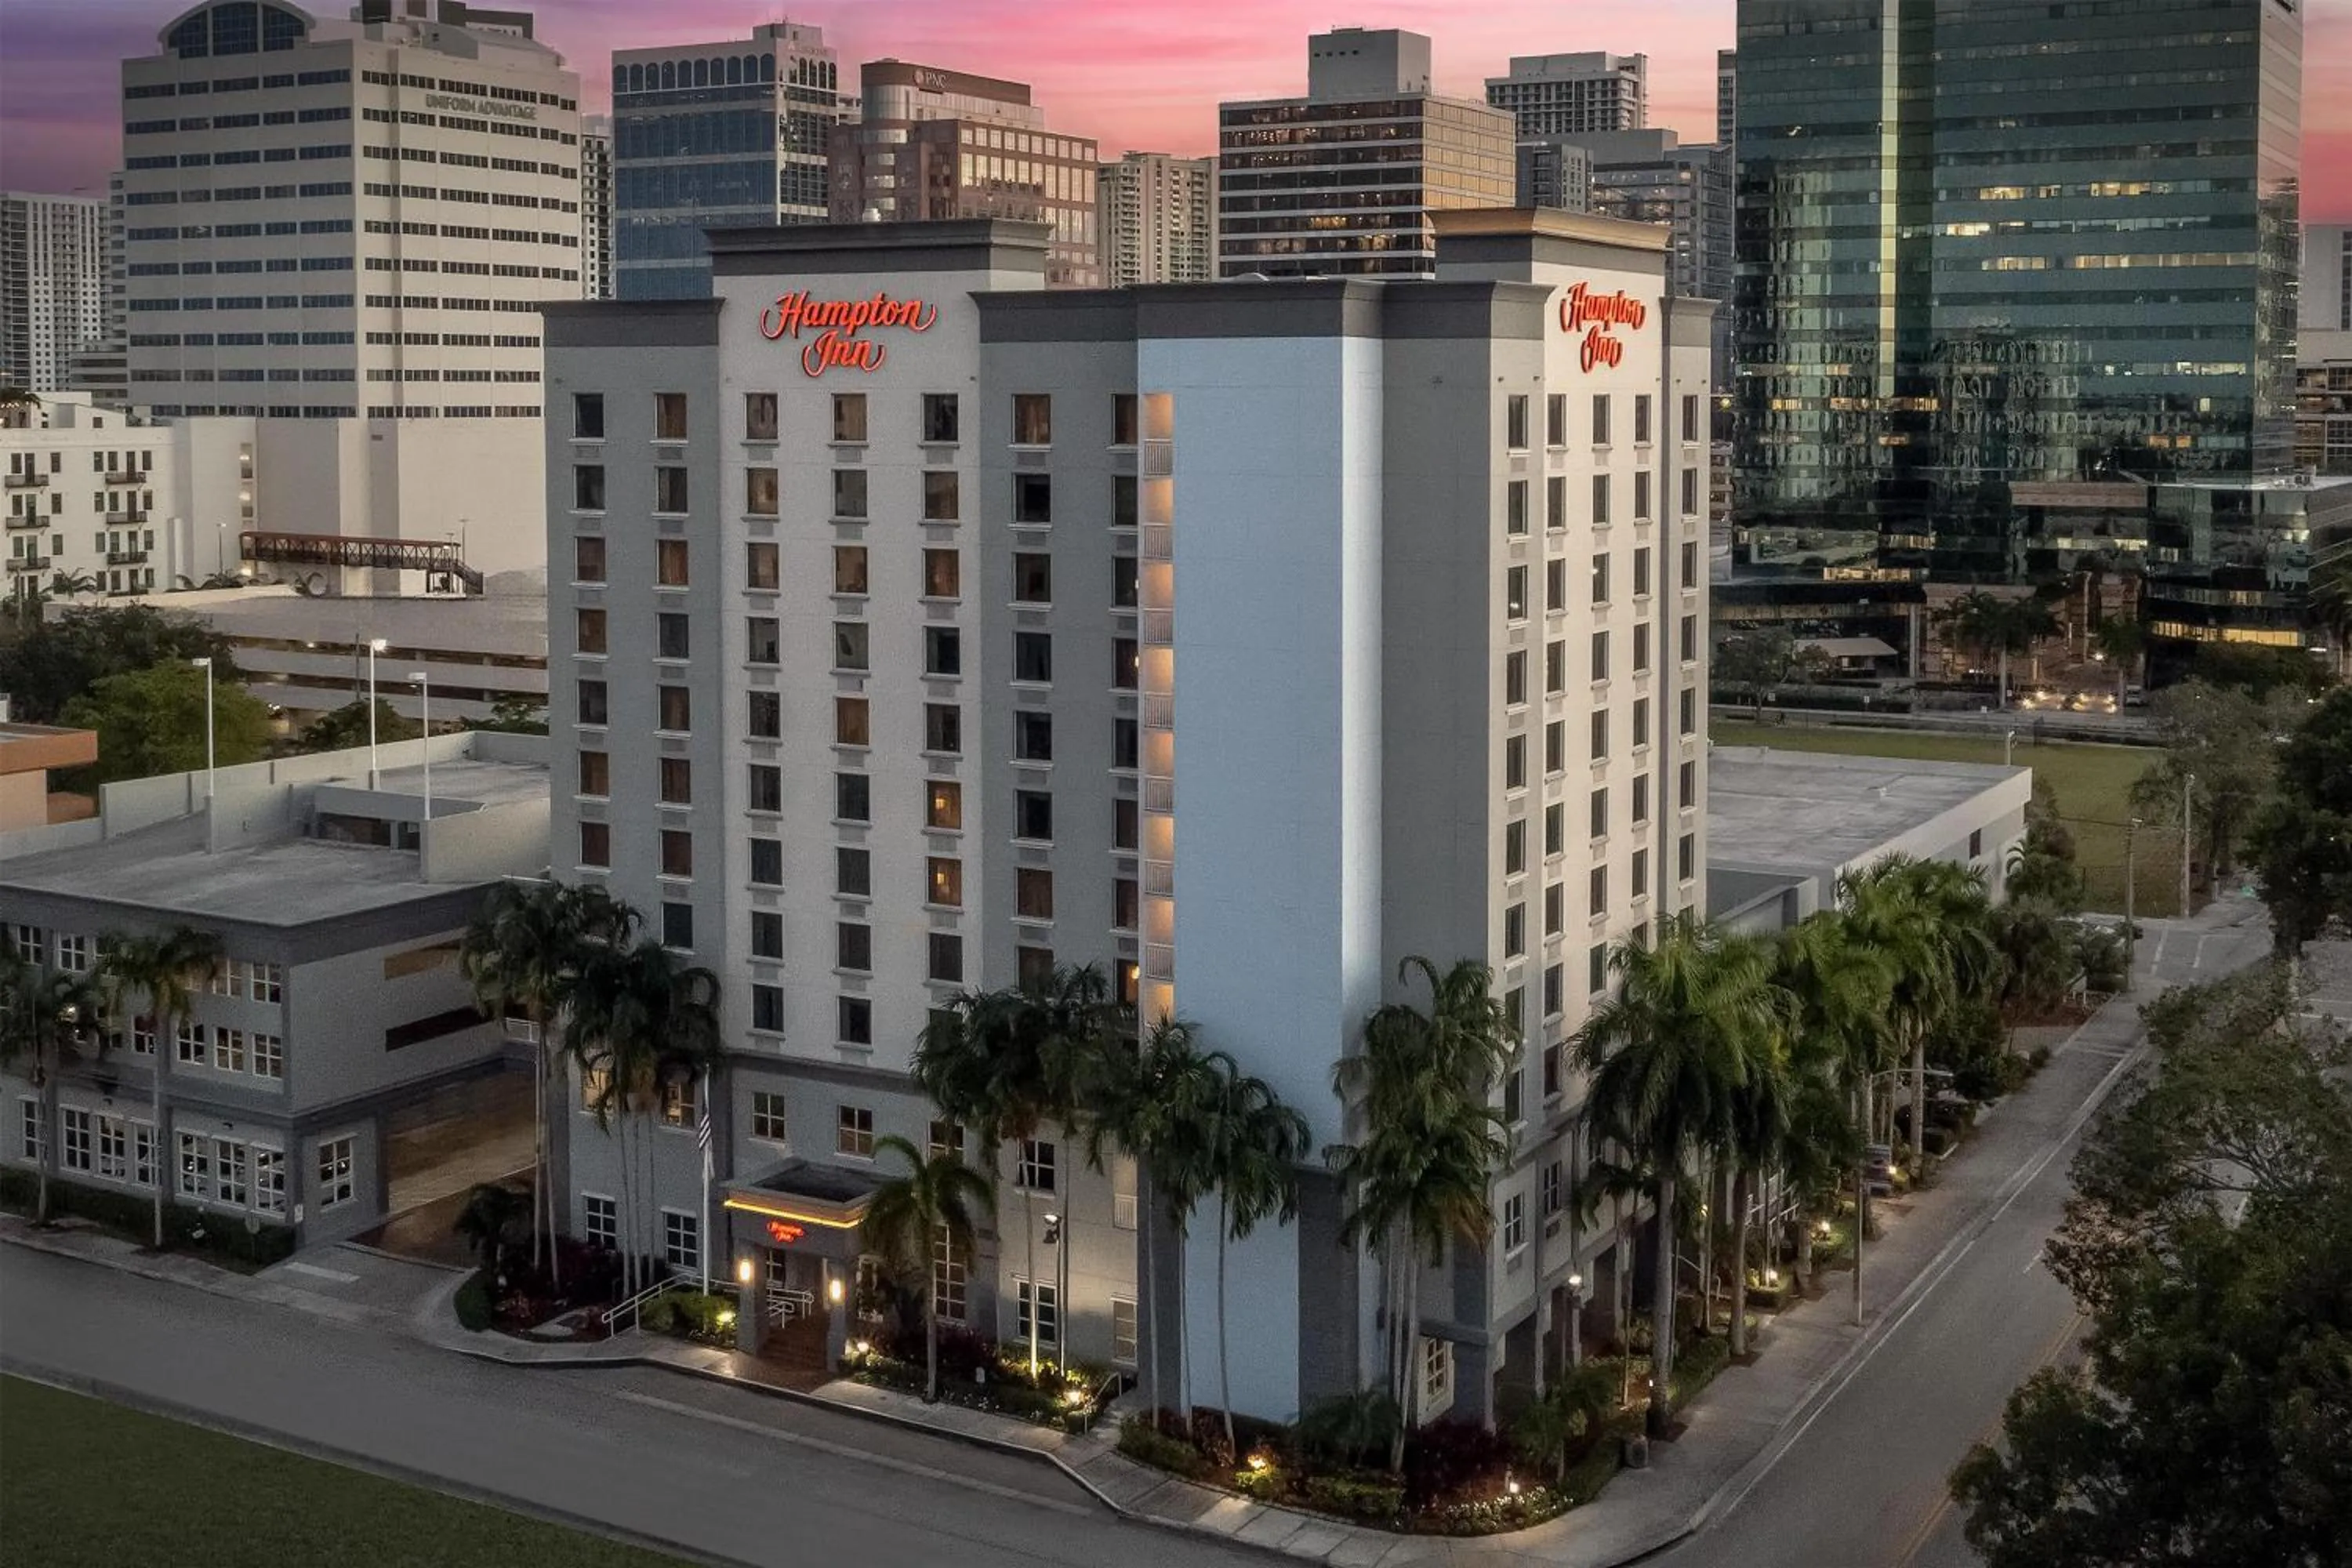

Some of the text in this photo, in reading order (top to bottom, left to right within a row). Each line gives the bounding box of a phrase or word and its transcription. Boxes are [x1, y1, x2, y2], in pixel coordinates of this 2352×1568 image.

[426, 93, 537, 120] UNIFORM ADVANTAGE
[760, 290, 937, 339] Hampton
[1559, 281, 1646, 332] Hampton
[802, 329, 886, 377] Inn
[1581, 325, 1624, 373] Inn
